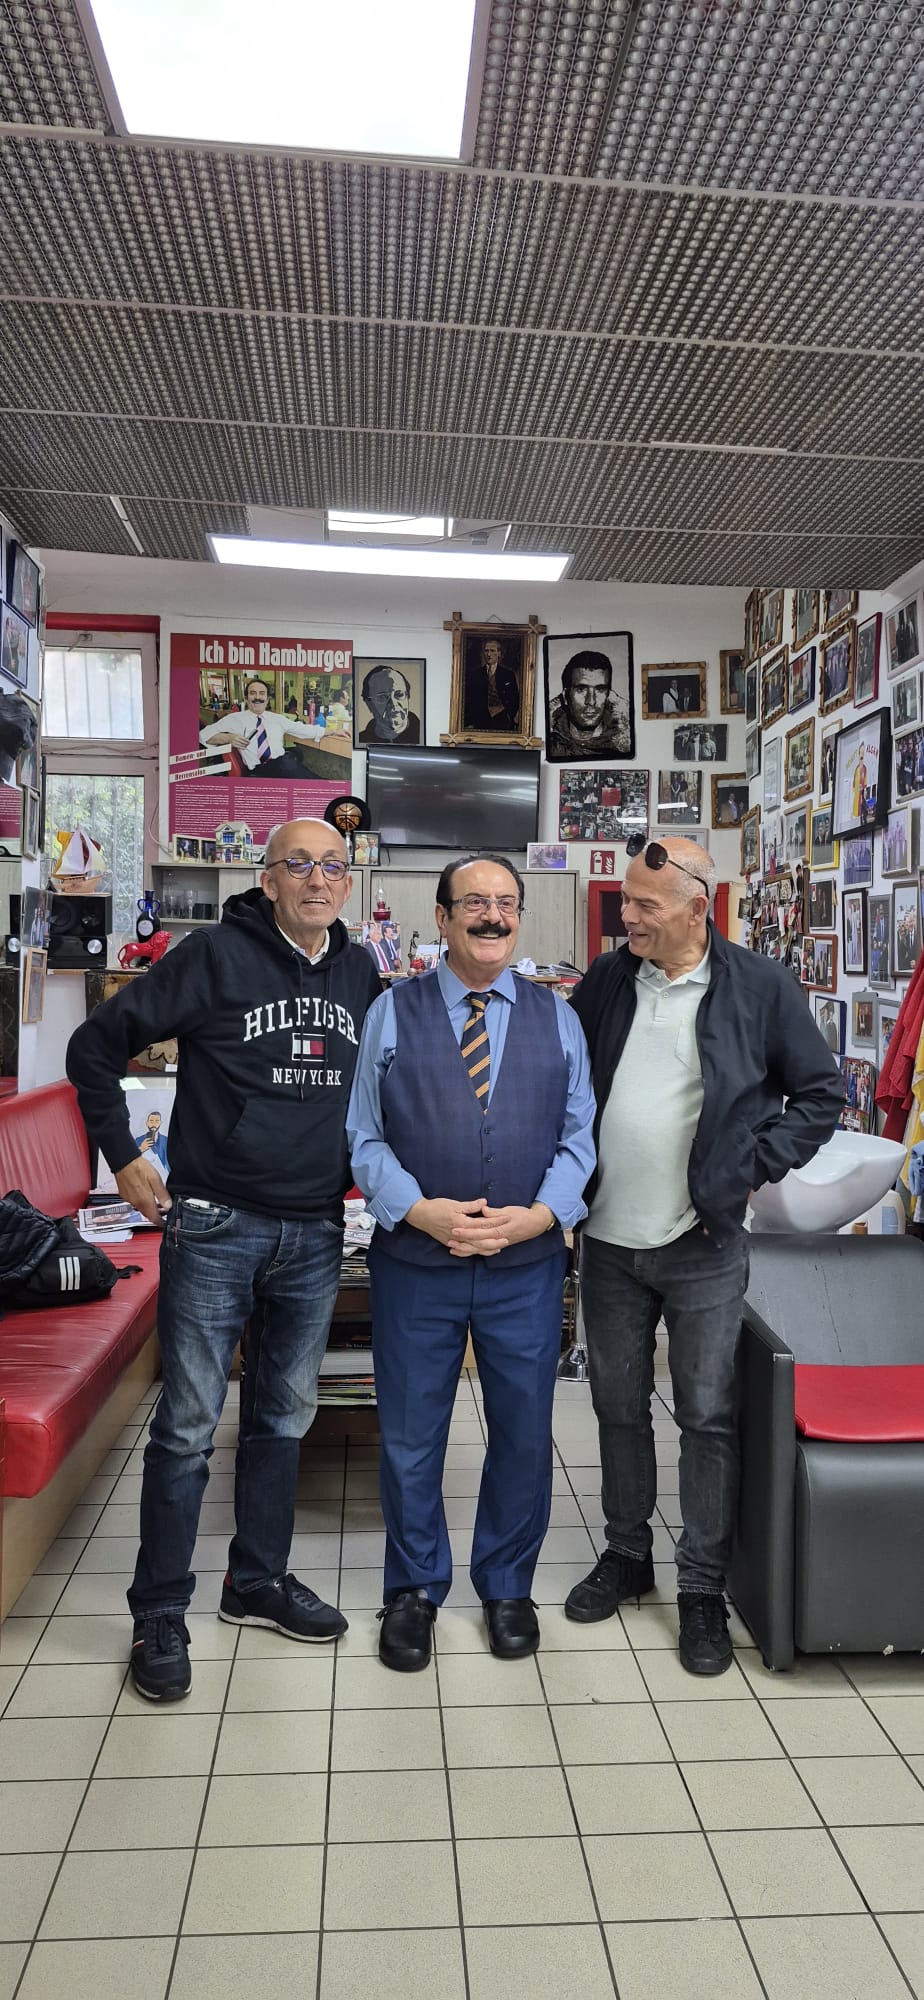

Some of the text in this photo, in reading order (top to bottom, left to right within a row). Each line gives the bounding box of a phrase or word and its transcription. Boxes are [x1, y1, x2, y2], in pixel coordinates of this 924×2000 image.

[200, 639, 352, 673] Ich bin Hamburger
[243, 997, 359, 1046] HILFIGER
[272, 1067, 307, 1085] NEW
